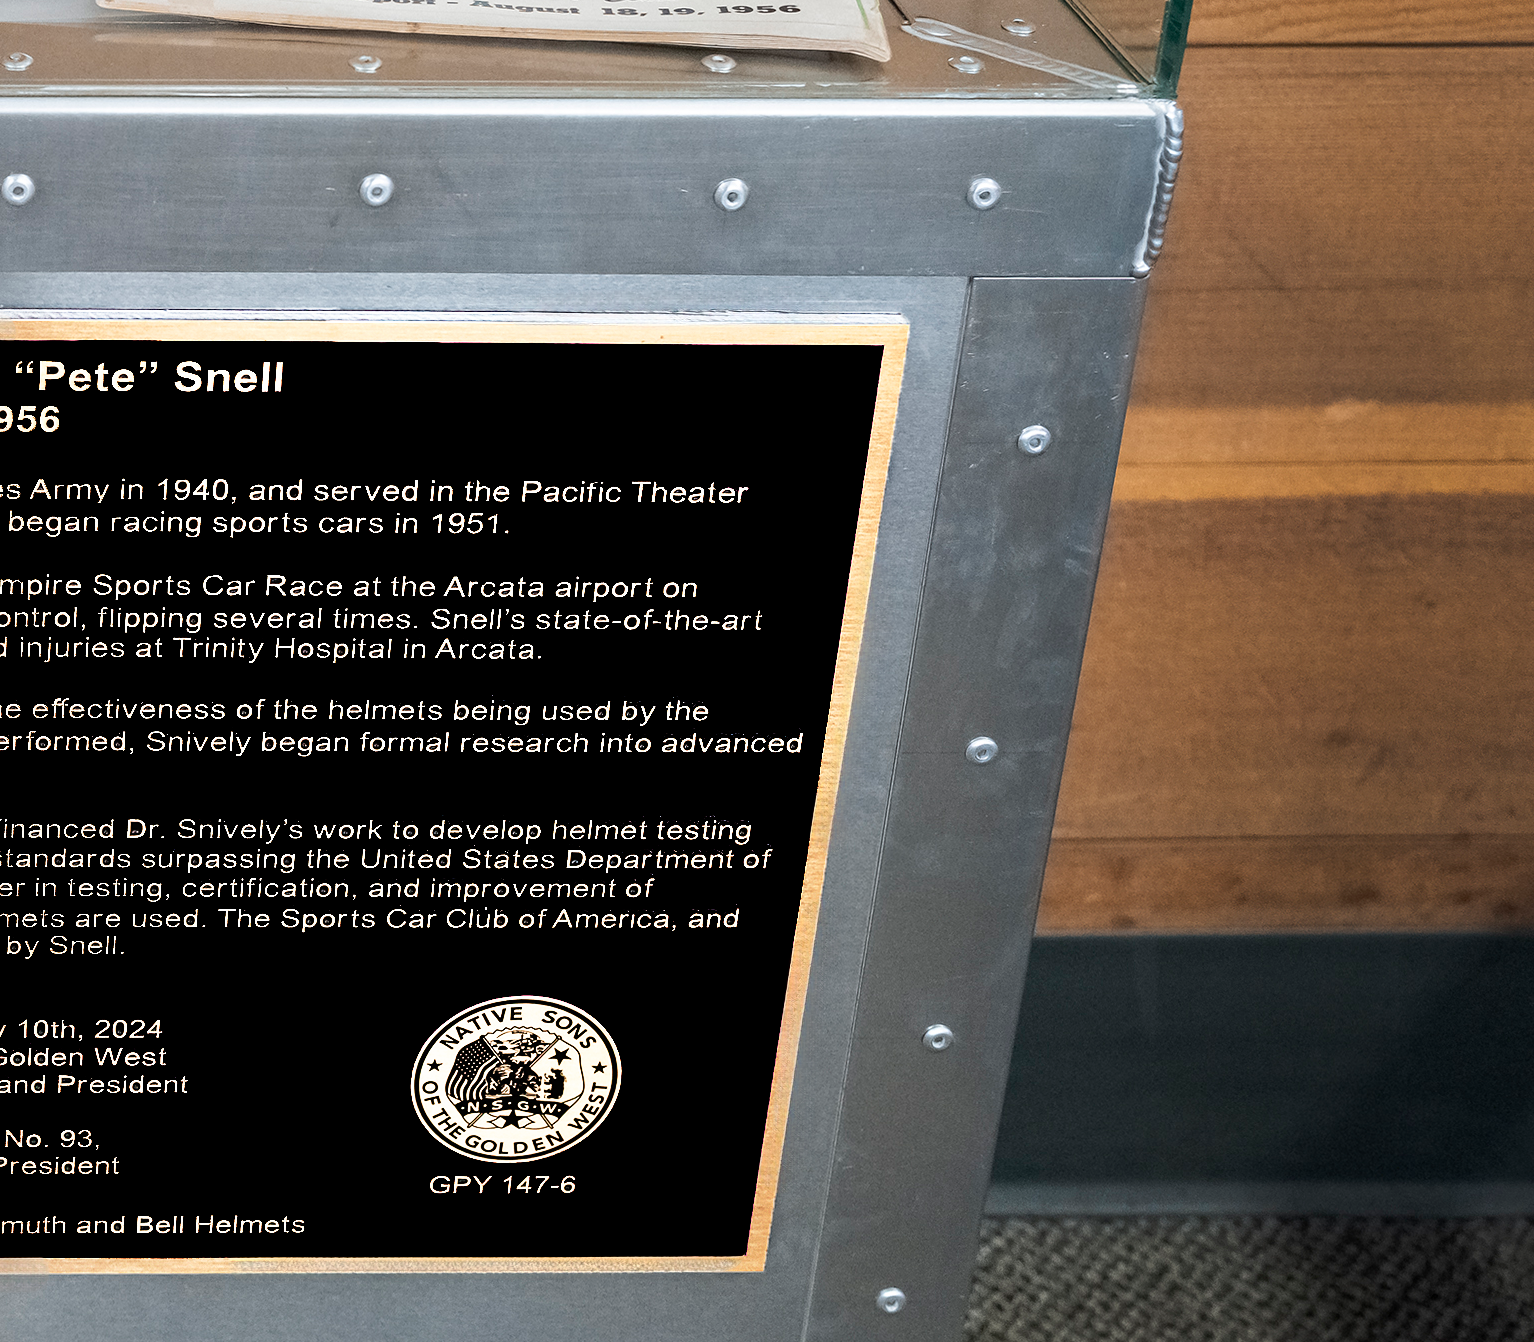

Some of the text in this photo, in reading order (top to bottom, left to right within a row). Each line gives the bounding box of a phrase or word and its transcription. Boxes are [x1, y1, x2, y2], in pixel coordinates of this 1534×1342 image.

[469, 0, 581, 14] August
[601, 7, 648, 17] 18,
[716, 5, 802, 14] 1956
[174, 360, 284, 393] Snell
[29, 478, 110, 504] Army
[120, 477, 144, 500] in
[157, 477, 237, 505] 1940,
[248, 478, 303, 501] and
[313, 479, 419, 502] served
[429, 479, 454, 502] in
[464, 479, 511, 503] the
[521, 480, 622, 503] Pacific
[631, 480, 750, 504] Theater
[6, 935, 40, 960] by
[49, 935, 125, 955] Snell.
[18, 1018, 83, 1042] 10th,
[94, 1019, 163, 1039] 2024
[439, 1006, 598, 1050] NATIVE SONS
[94, 1047, 167, 1067] West
[57, 1074, 189, 1094] President
[422, 1080, 608, 1155] OF THE GOLDEN WEST
[4, 1129, 49, 1148] No.
[60, 1129, 100, 1151] 93,
[429, 1176, 576, 1194] GPY 147-6
[76, 1215, 126, 1234] and
[136, 1215, 184, 1234] Bell
[195, 1214, 305, 1234] Helmets
